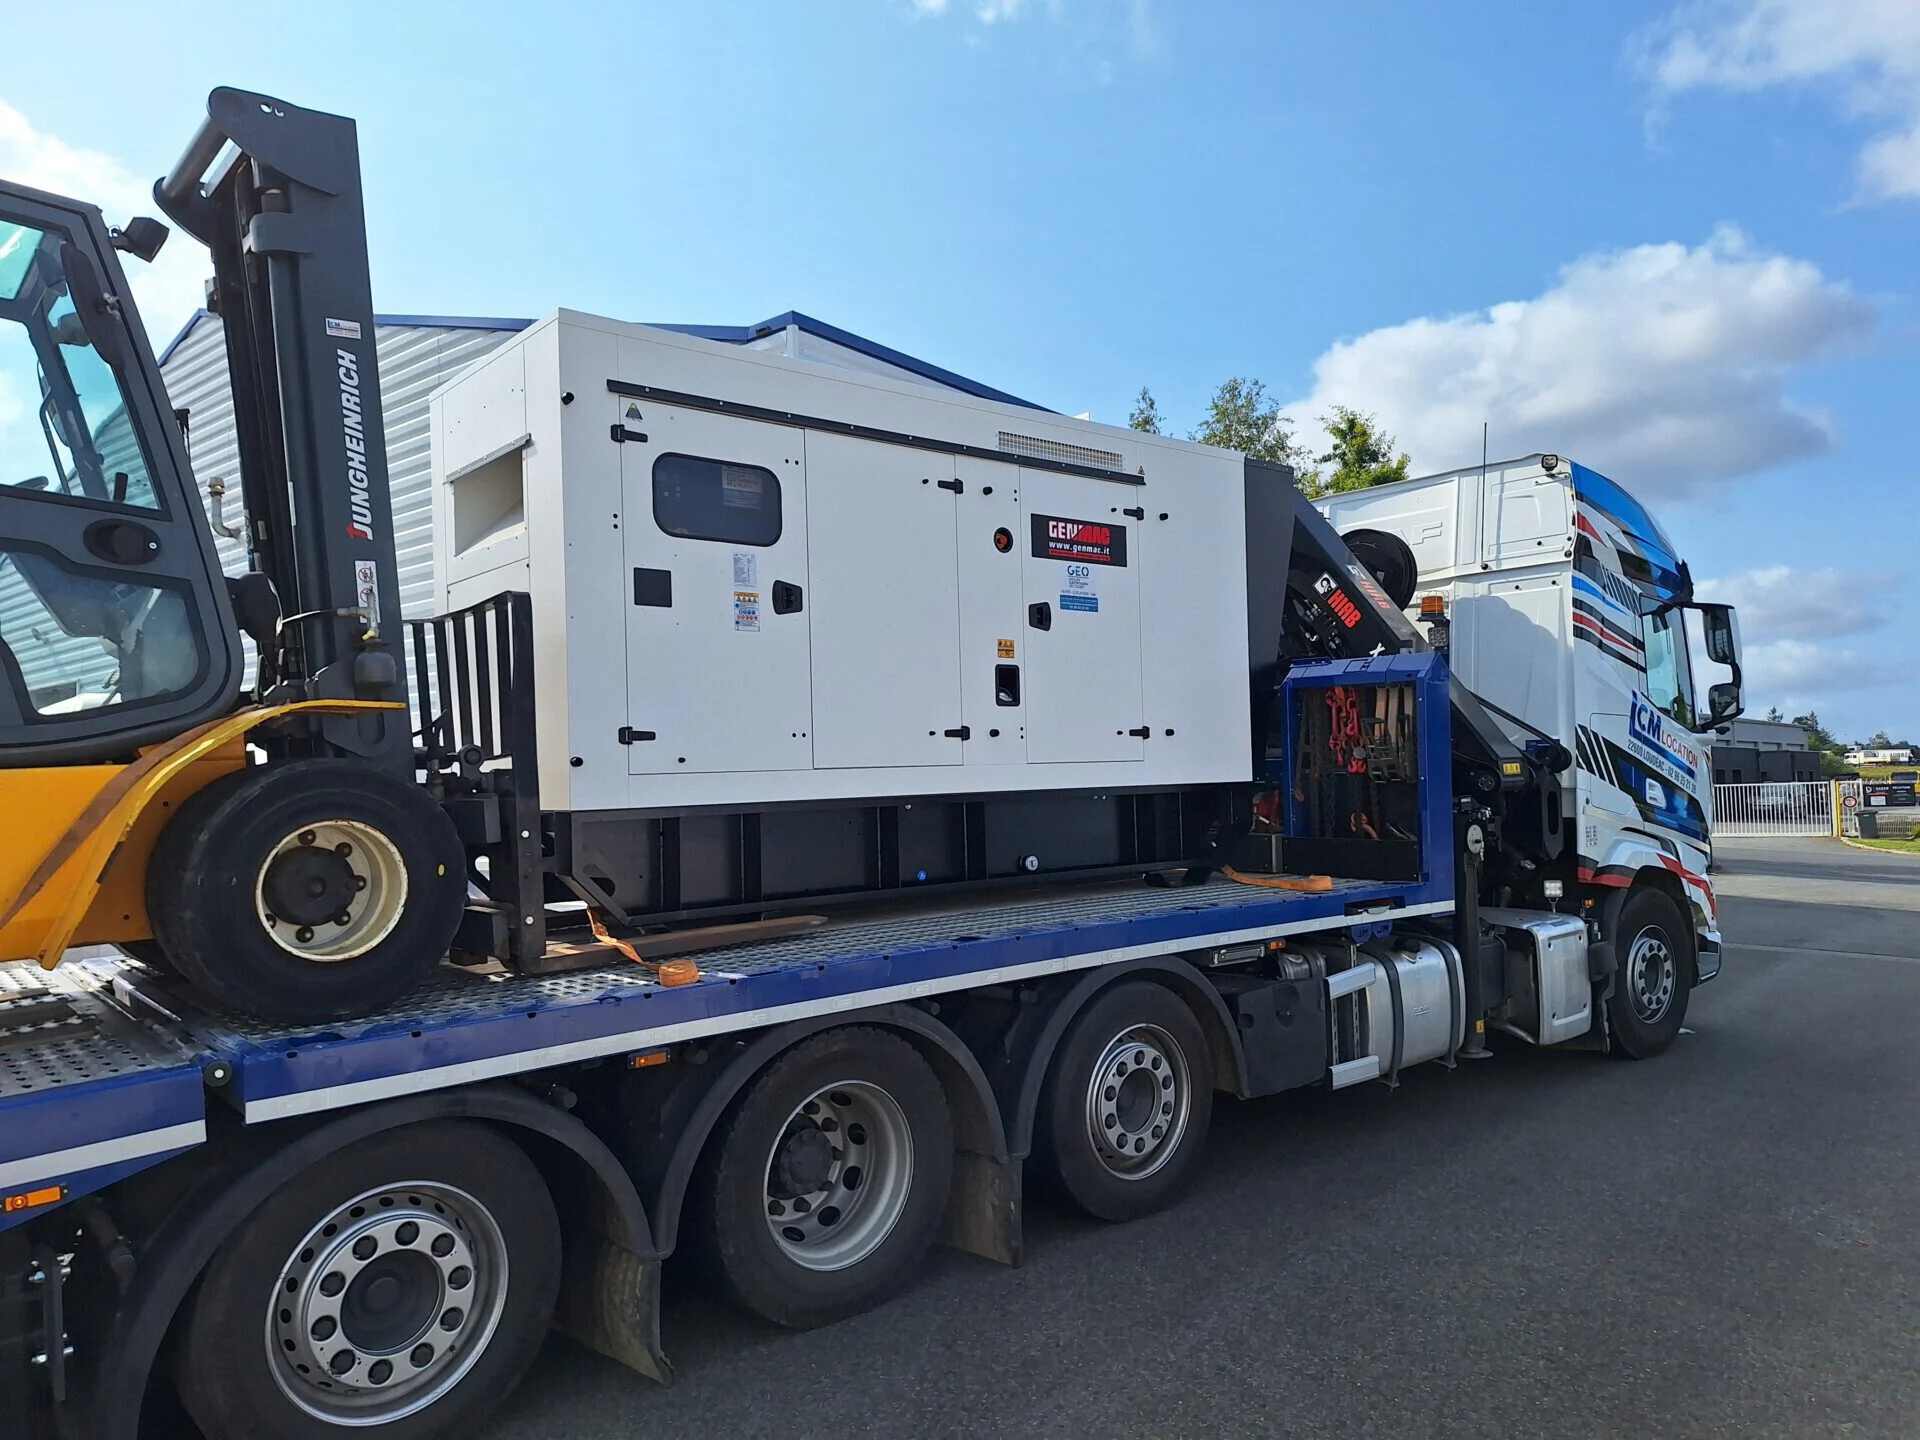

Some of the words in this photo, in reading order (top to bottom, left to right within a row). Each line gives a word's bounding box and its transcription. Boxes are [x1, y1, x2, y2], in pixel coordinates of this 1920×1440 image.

[338, 348, 373, 541] JUNGHEINRICH
[1049, 521, 1110, 545] GENMAC
[1049, 542, 1109, 554] www.genmac.it
[1067, 565, 1089, 577] GEO
[1327, 589, 1361, 628] HIAB
[1627, 739, 1643, 757] 22600
[1667, 766, 1675, 778] 02
[1674, 771, 1681, 782] 96
[1680, 775, 1686, 786] 25
[1685, 779, 1691, 790] 21
[1662, 730, 1698, 769] LOCATION
